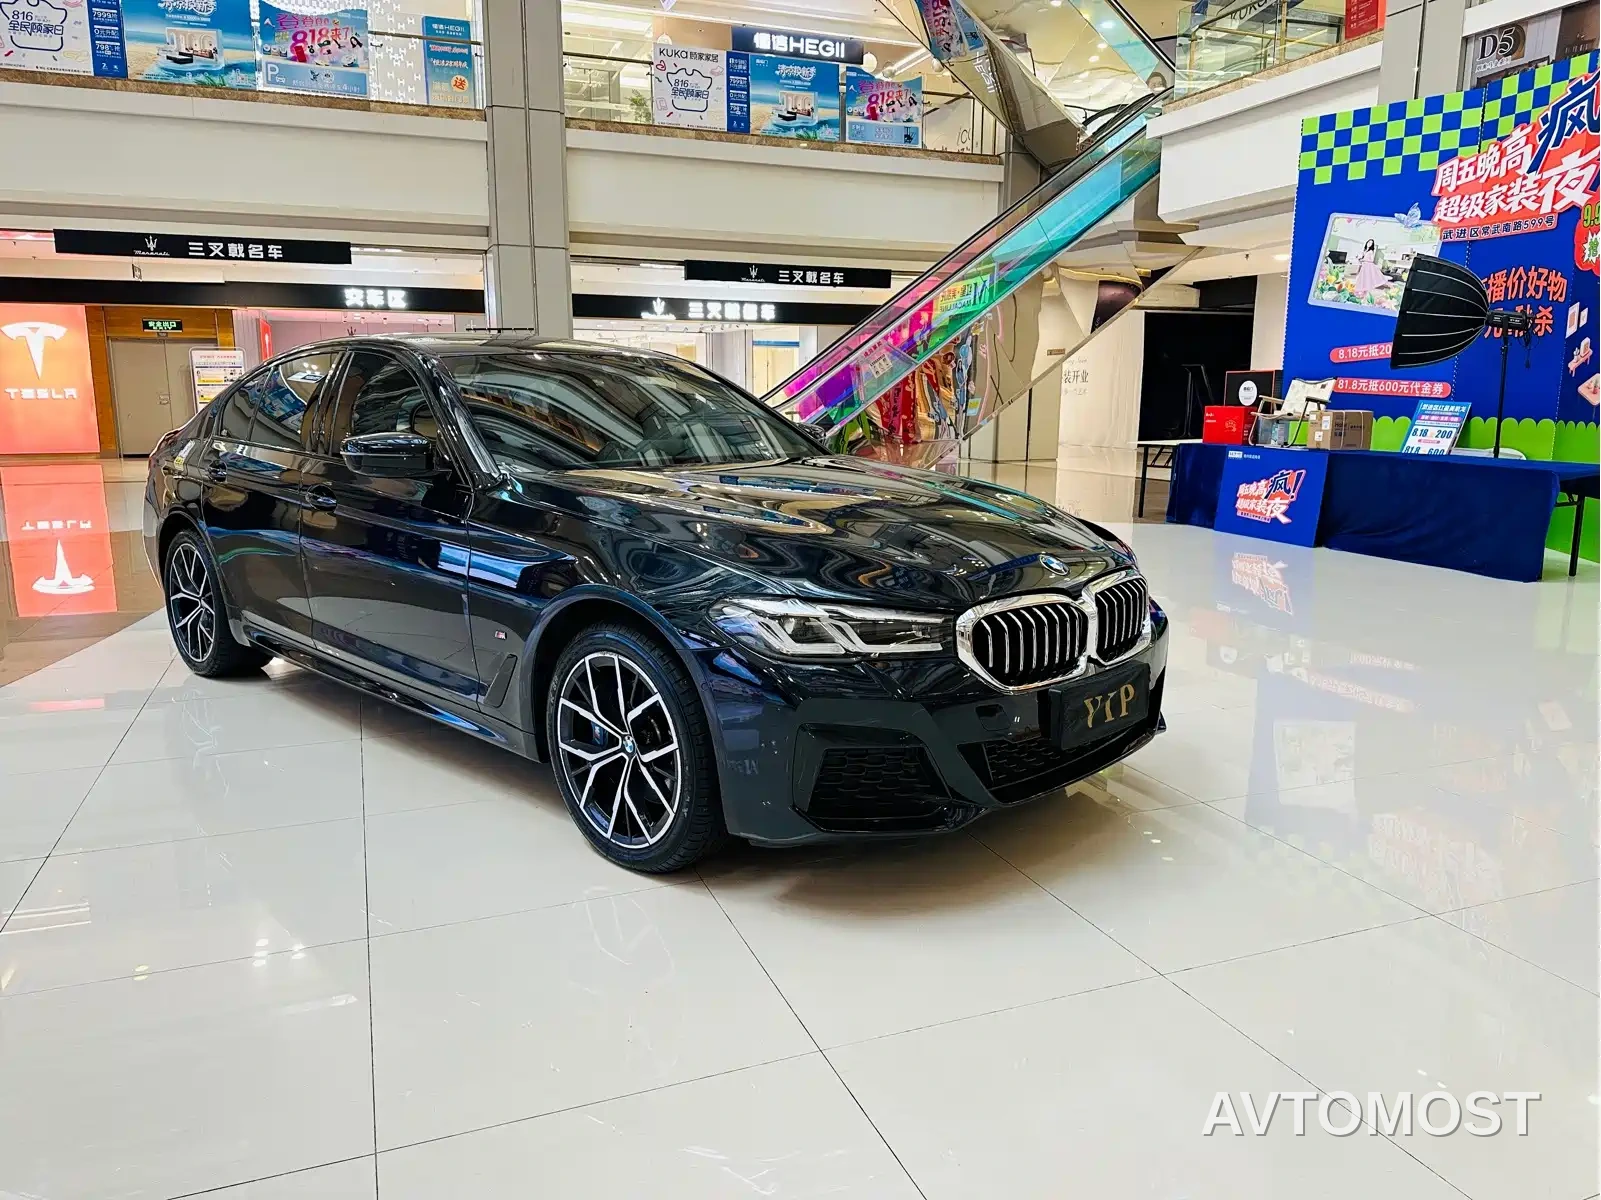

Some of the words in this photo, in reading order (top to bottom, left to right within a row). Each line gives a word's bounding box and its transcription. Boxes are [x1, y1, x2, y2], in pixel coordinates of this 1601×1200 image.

[12, 10, 34, 21] 816
[8, 20, 64, 36] 全民顾家日
[1476, 26, 1516, 62] D5
[453, 76, 466, 91] 送
[674, 78, 689, 88] 816
[1432, 148, 1593, 224] 超级家装夜
[1442, 215, 1555, 240] 武进区常武南路599号
[188, 241, 283, 259] 三叉戟名车
[778, 270, 844, 285] 三叉戟名车
[1480, 265, 1567, 303] 播价好物
[4, 387, 78, 400] TESLA
[1337, 378, 1444, 395] 81.8元抵600元代金券
[1411, 428, 1428, 437] 8.18
[1435, 429, 1453, 439] 200
